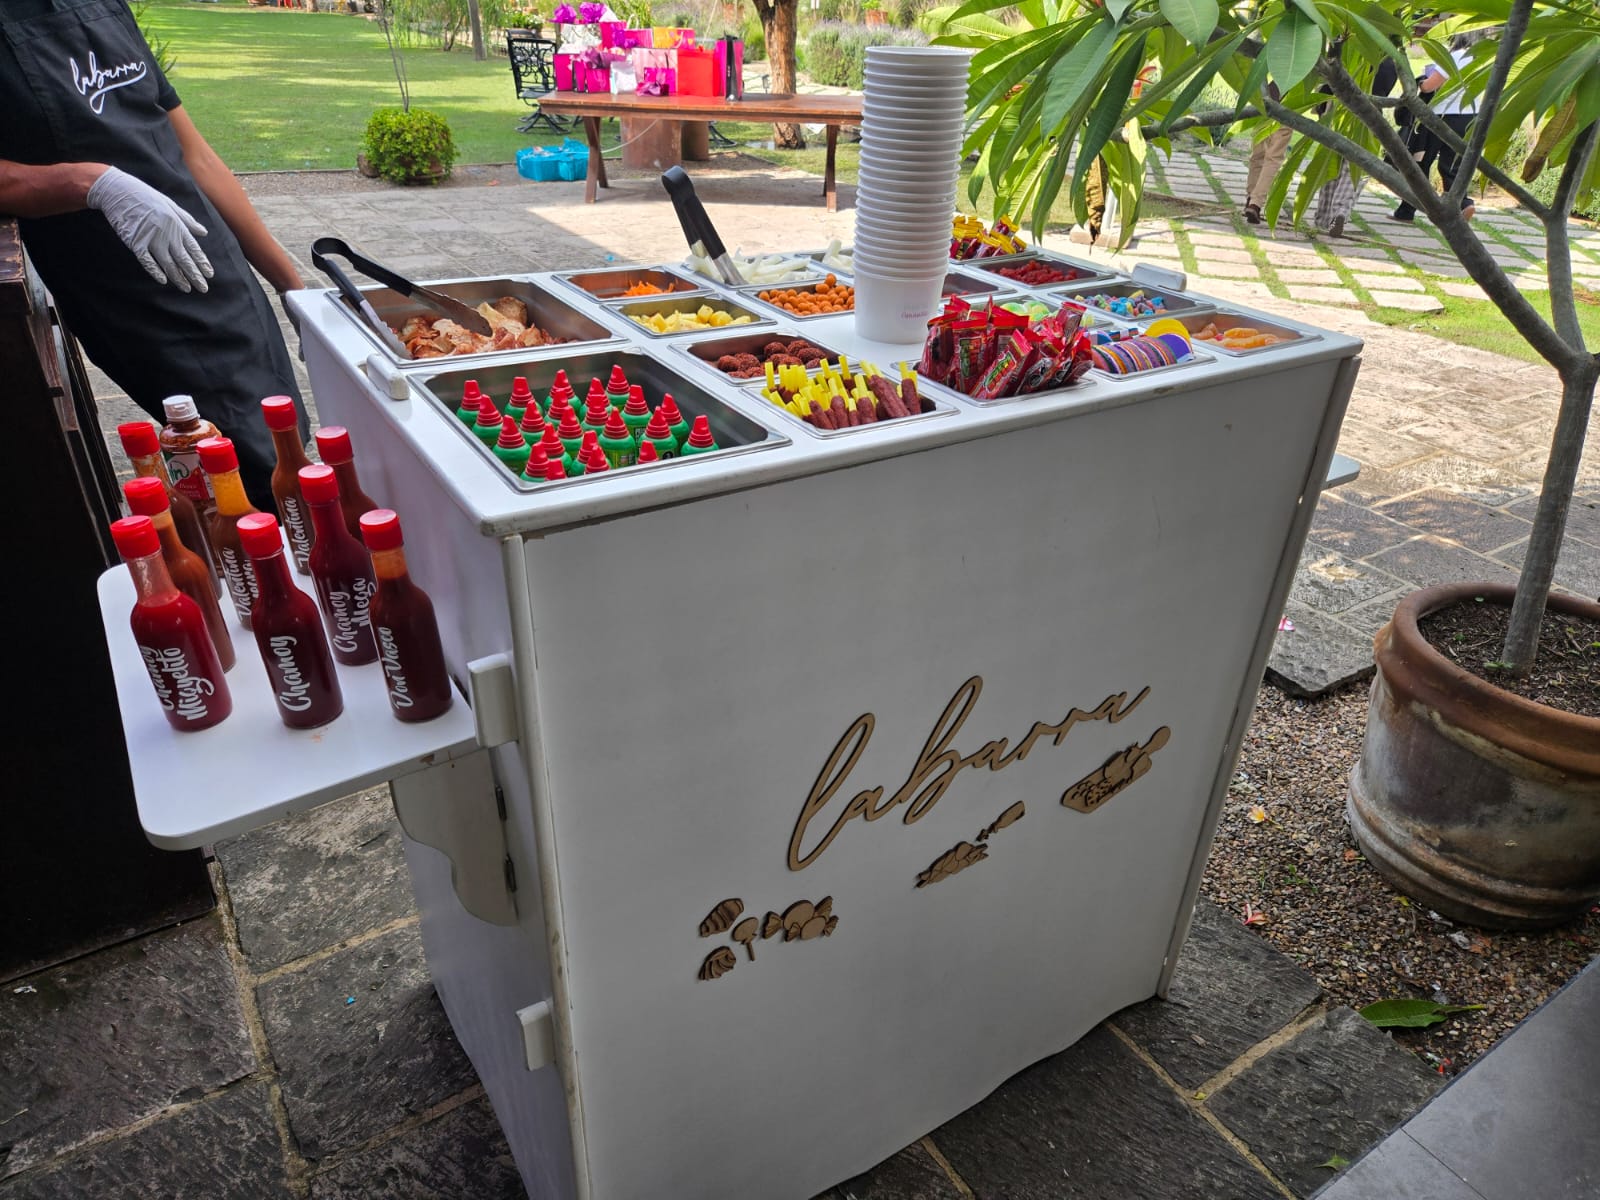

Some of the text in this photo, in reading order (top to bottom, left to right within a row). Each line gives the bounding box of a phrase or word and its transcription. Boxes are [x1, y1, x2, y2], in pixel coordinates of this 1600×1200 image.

[284, 496, 310, 568] Valentina
[222, 547, 252, 620] Valentina
[351, 577, 377, 627] Mega
[330, 591, 358, 653] Chamoy
[270, 635, 312, 711] Chamoy
[378, 626, 414, 709] Don Vasco
